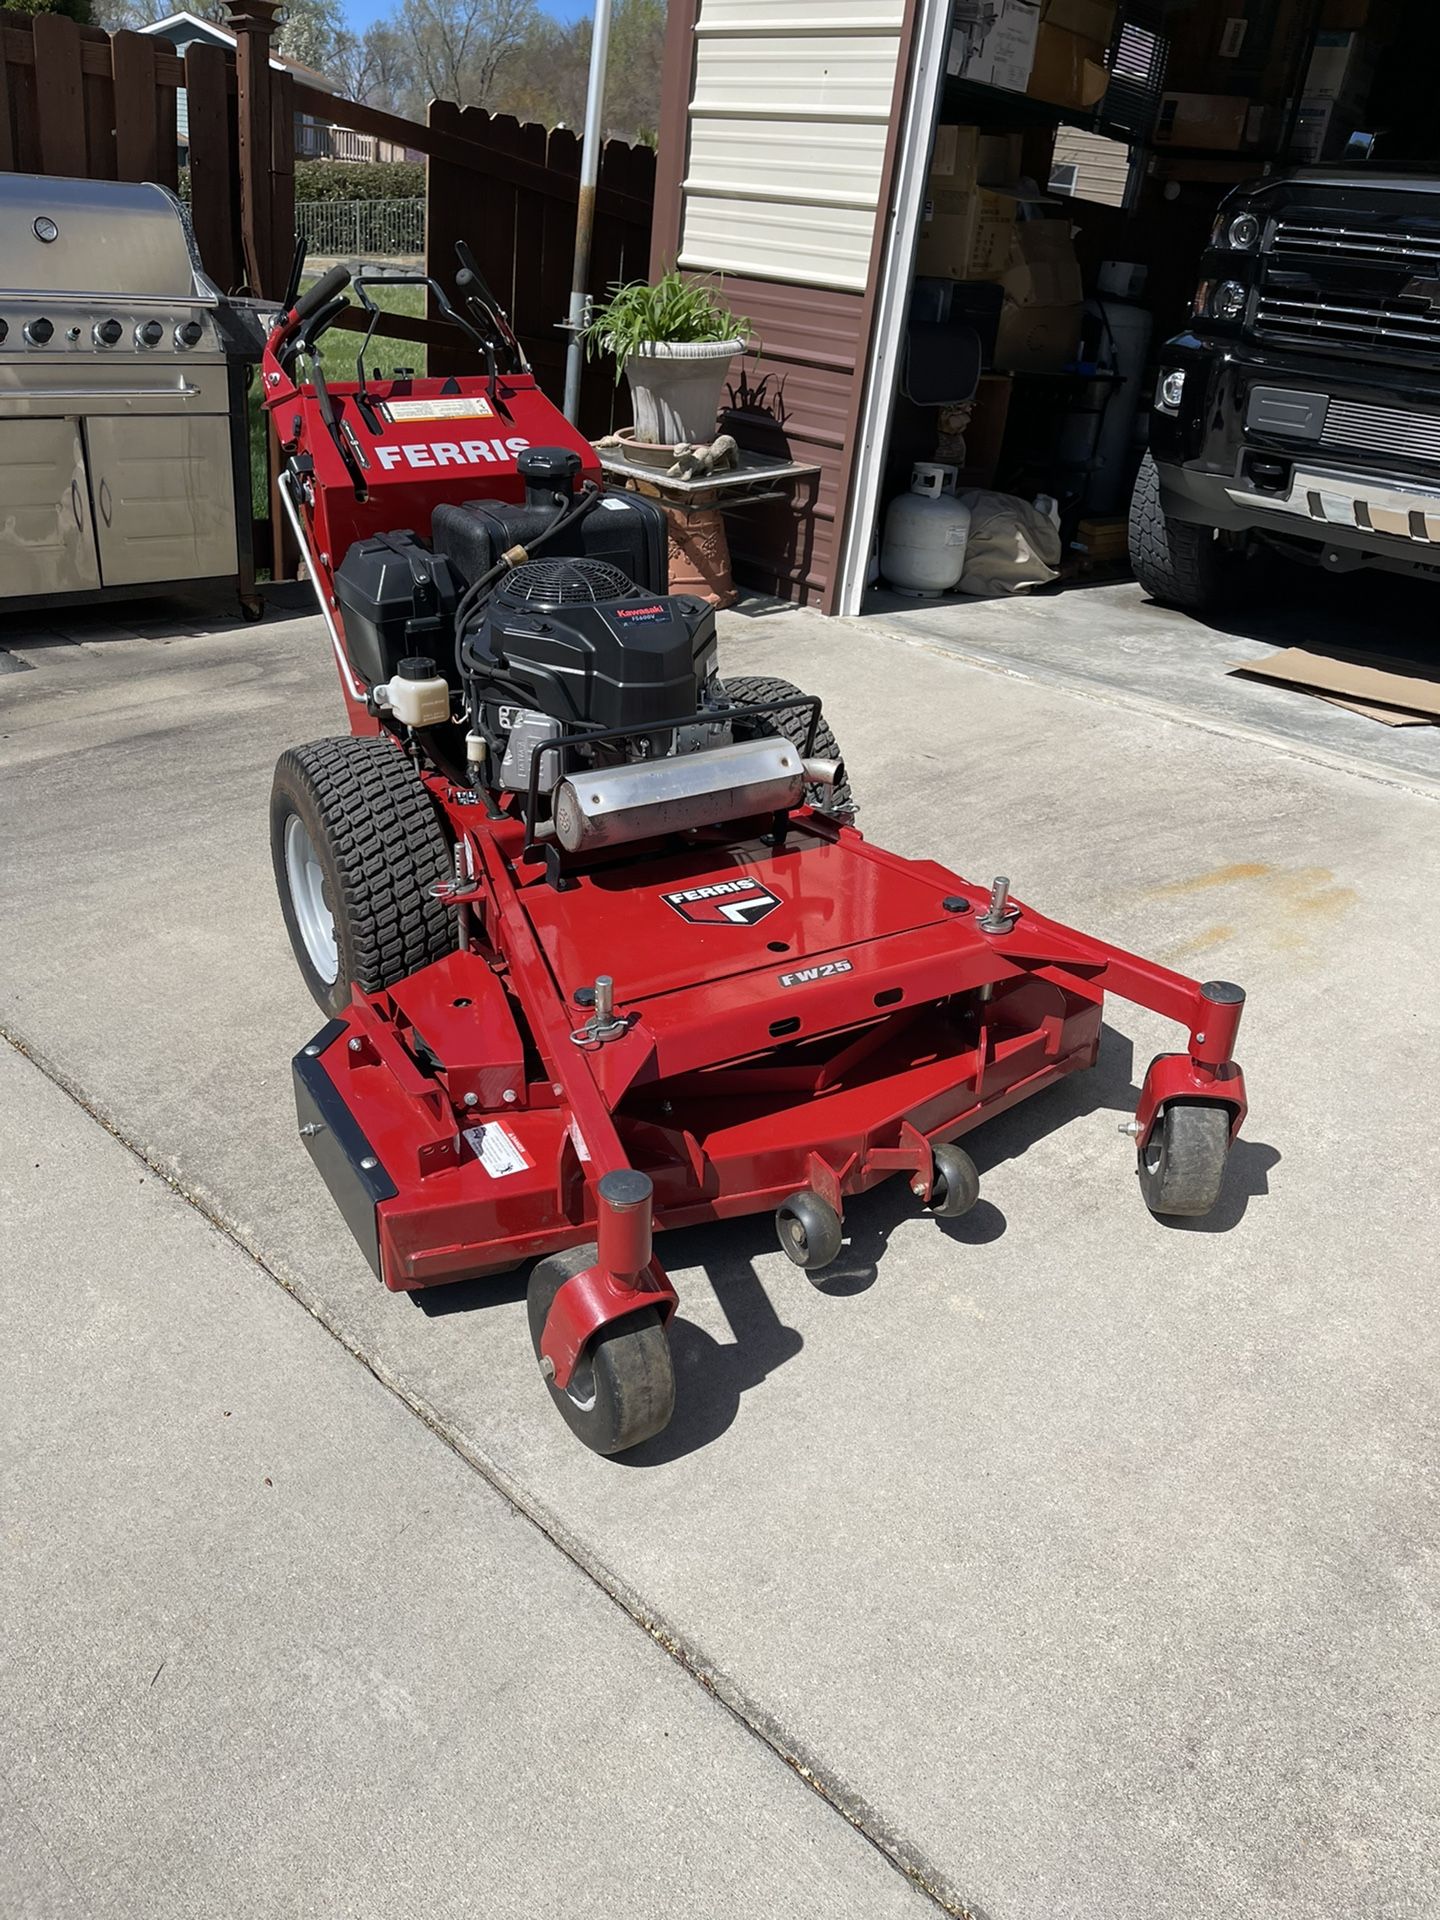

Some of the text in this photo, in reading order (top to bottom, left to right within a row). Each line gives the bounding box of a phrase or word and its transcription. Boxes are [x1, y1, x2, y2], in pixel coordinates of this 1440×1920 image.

[374, 437, 530, 470] FERRIS
[616, 605, 664, 617] Kawasaki
[668, 879, 755, 903] FERRIS
[782, 960, 852, 986] FW25
